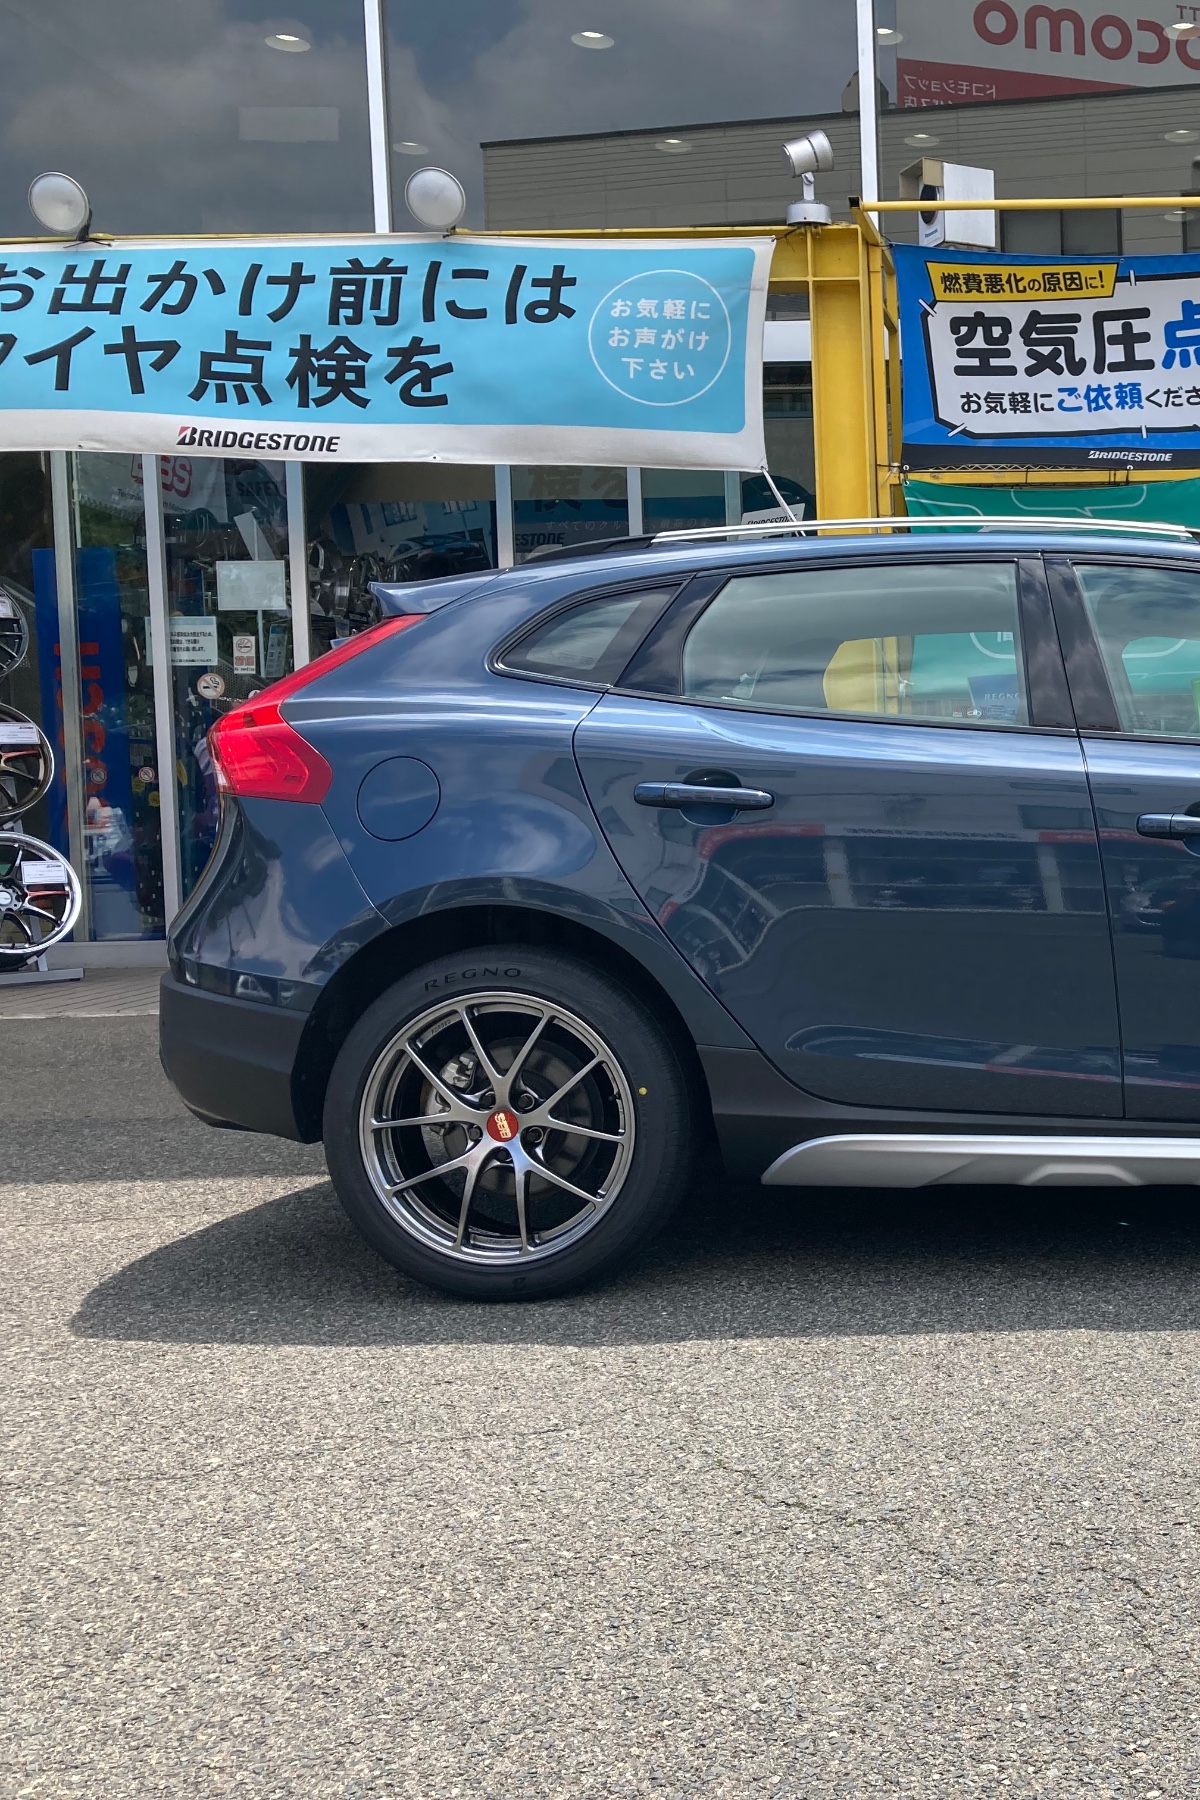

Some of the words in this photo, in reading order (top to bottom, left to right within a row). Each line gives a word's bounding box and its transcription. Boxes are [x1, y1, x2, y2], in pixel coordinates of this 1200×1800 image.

[0, 256, 577, 326] お出かけ前には
[940, 269, 1106, 294] 燃費悪化の原因に!
[611, 296, 712, 321] お気軽に
[607, 326, 710, 353] お声がけ
[0, 325, 454, 409] イヤ点検を
[620, 357, 696, 382] 下さい
[176, 424, 341, 453] BRIDGESTONE
[1087, 449, 1173, 463] BRIDGESTONE
[424, 966, 522, 992] REGNO
[494, 1112, 512, 1139] BBS
